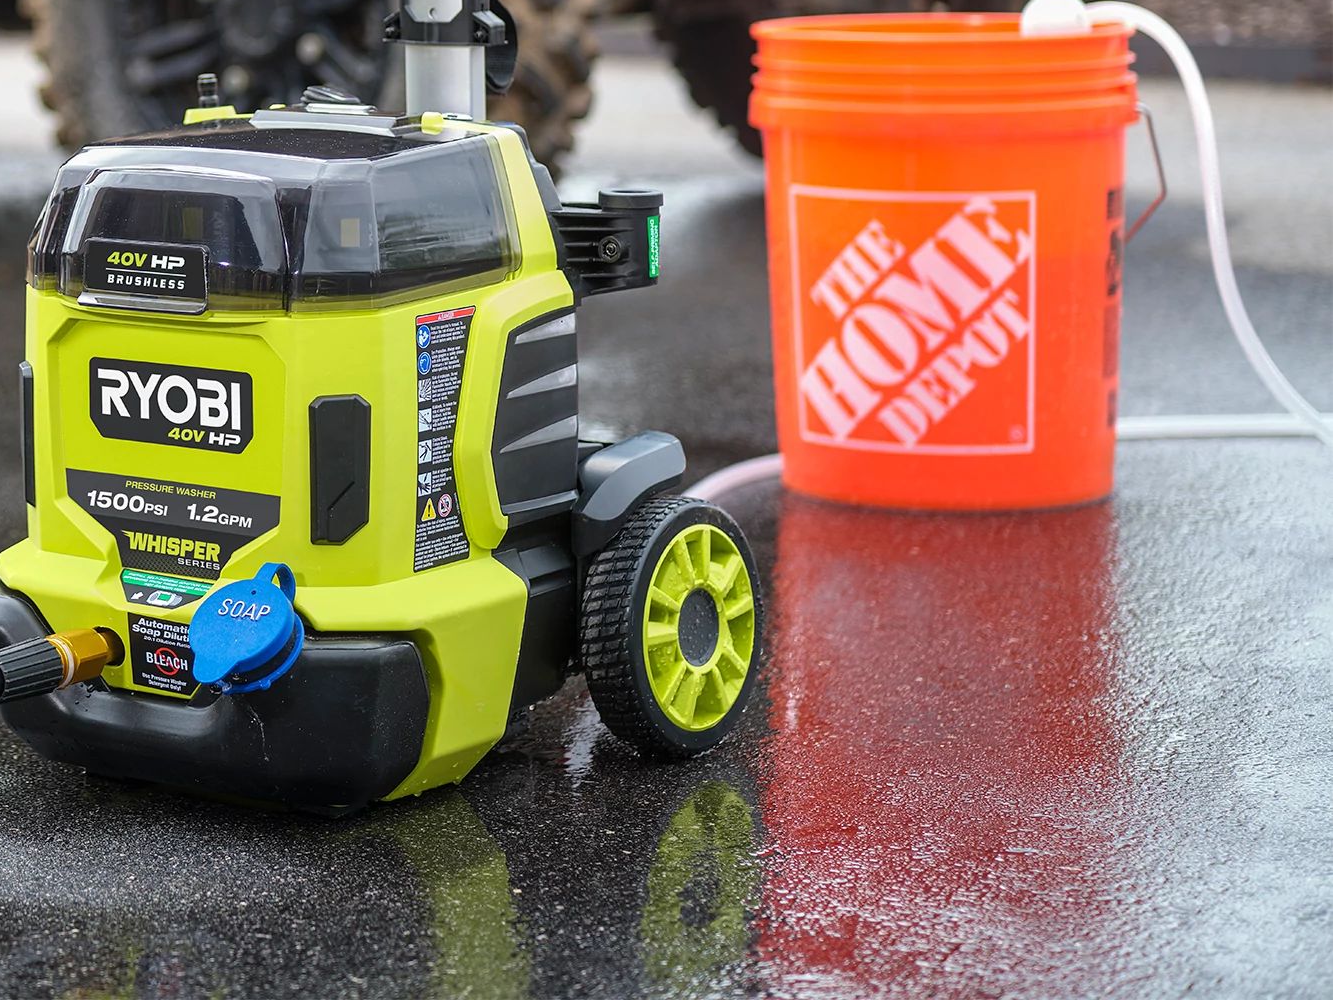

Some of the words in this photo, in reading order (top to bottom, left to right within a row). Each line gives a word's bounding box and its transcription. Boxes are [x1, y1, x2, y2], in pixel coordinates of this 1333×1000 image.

[107, 251, 148, 267] 40V
[150, 254, 185, 269] HP
[810, 218, 906, 321] THE
[107, 273, 185, 290] BRUSHLESS
[800, 196, 1031, 442] HOME
[877, 287, 1031, 450] DEPOT
[97, 367, 241, 430] RYOBI
[167, 427, 205, 443] 40V
[208, 431, 241, 446] HP
[125, 480, 174, 494] PRESSURE
[176, 486, 216, 500] WASHER
[121, 529, 221, 562] WHISPER
[177, 557, 220, 571] SERIES
[217, 598, 271, 621] SOAP
[132, 623, 161, 637] Soap
[163, 631, 190, 642] Diluti
[138, 617, 189, 634] Automati
[146, 651, 188, 670] BLEACH
